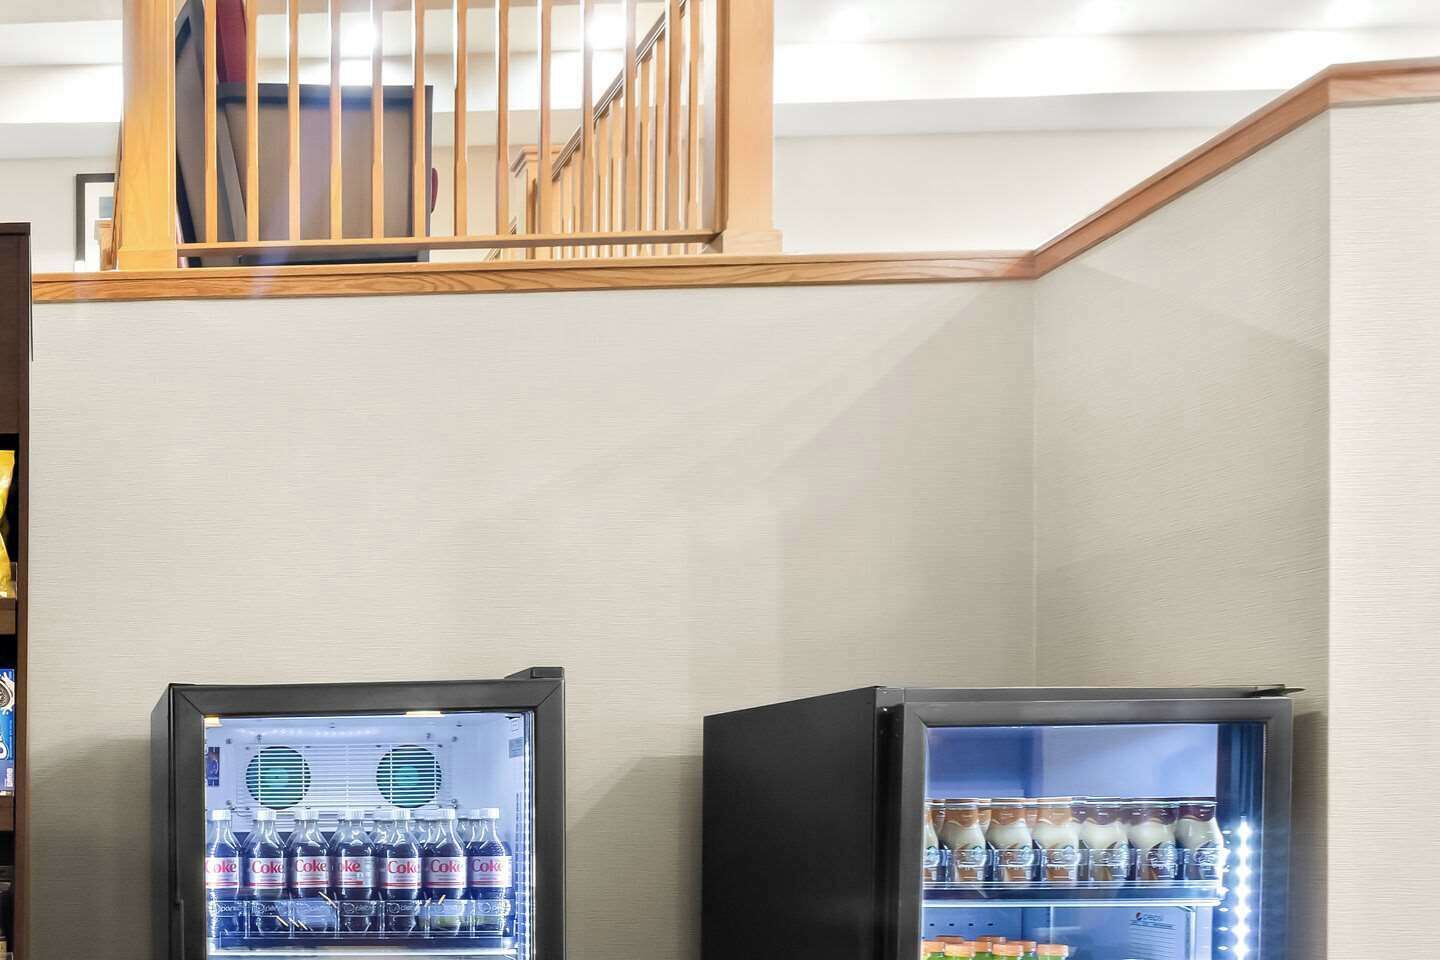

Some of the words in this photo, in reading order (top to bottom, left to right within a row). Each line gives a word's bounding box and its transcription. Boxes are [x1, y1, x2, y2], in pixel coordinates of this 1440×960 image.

[251, 860, 285, 873] Coke
[295, 859, 327, 872] Coke
[339, 860, 361, 872] oke
